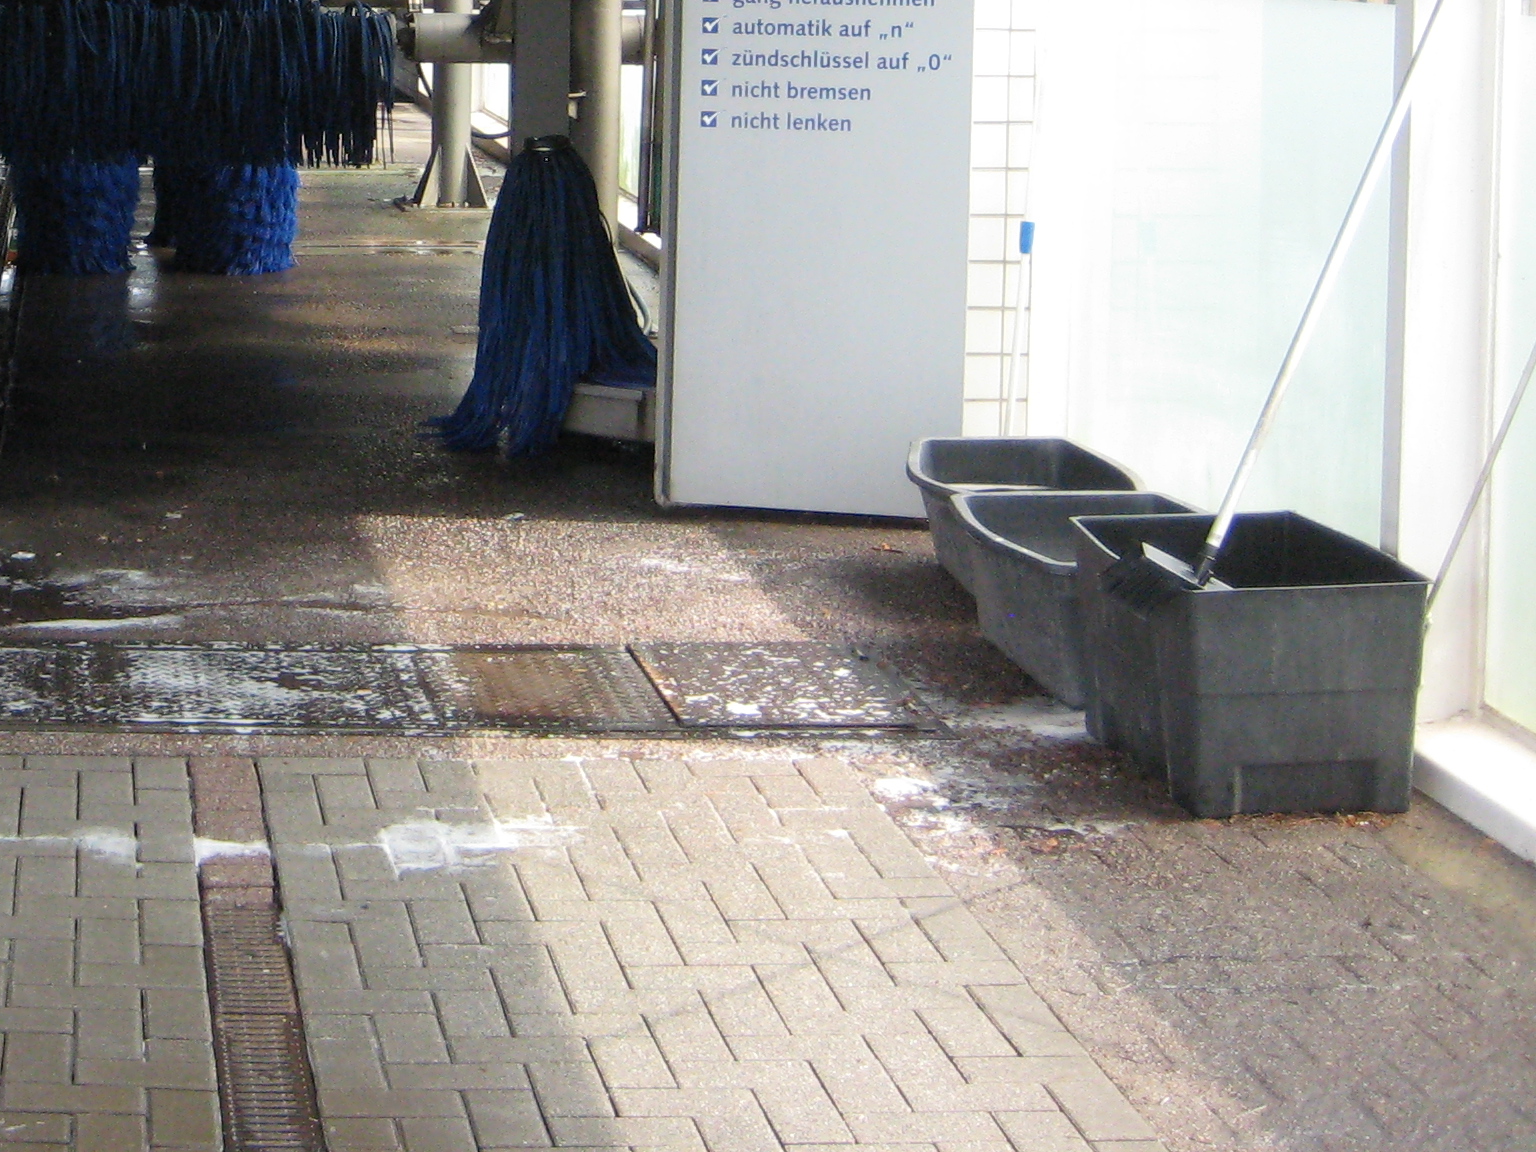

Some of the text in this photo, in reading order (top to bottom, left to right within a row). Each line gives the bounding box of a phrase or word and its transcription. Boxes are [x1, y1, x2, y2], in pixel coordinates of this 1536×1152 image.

[732, 18, 833, 37] automatik
[838, 19, 872, 38] auf
[731, 50, 870, 69] zündschlüssel
[876, 51, 910, 70] auf
[731, 81, 872, 101] nicht bremsen
[730, 112, 852, 132] nicht lenken
